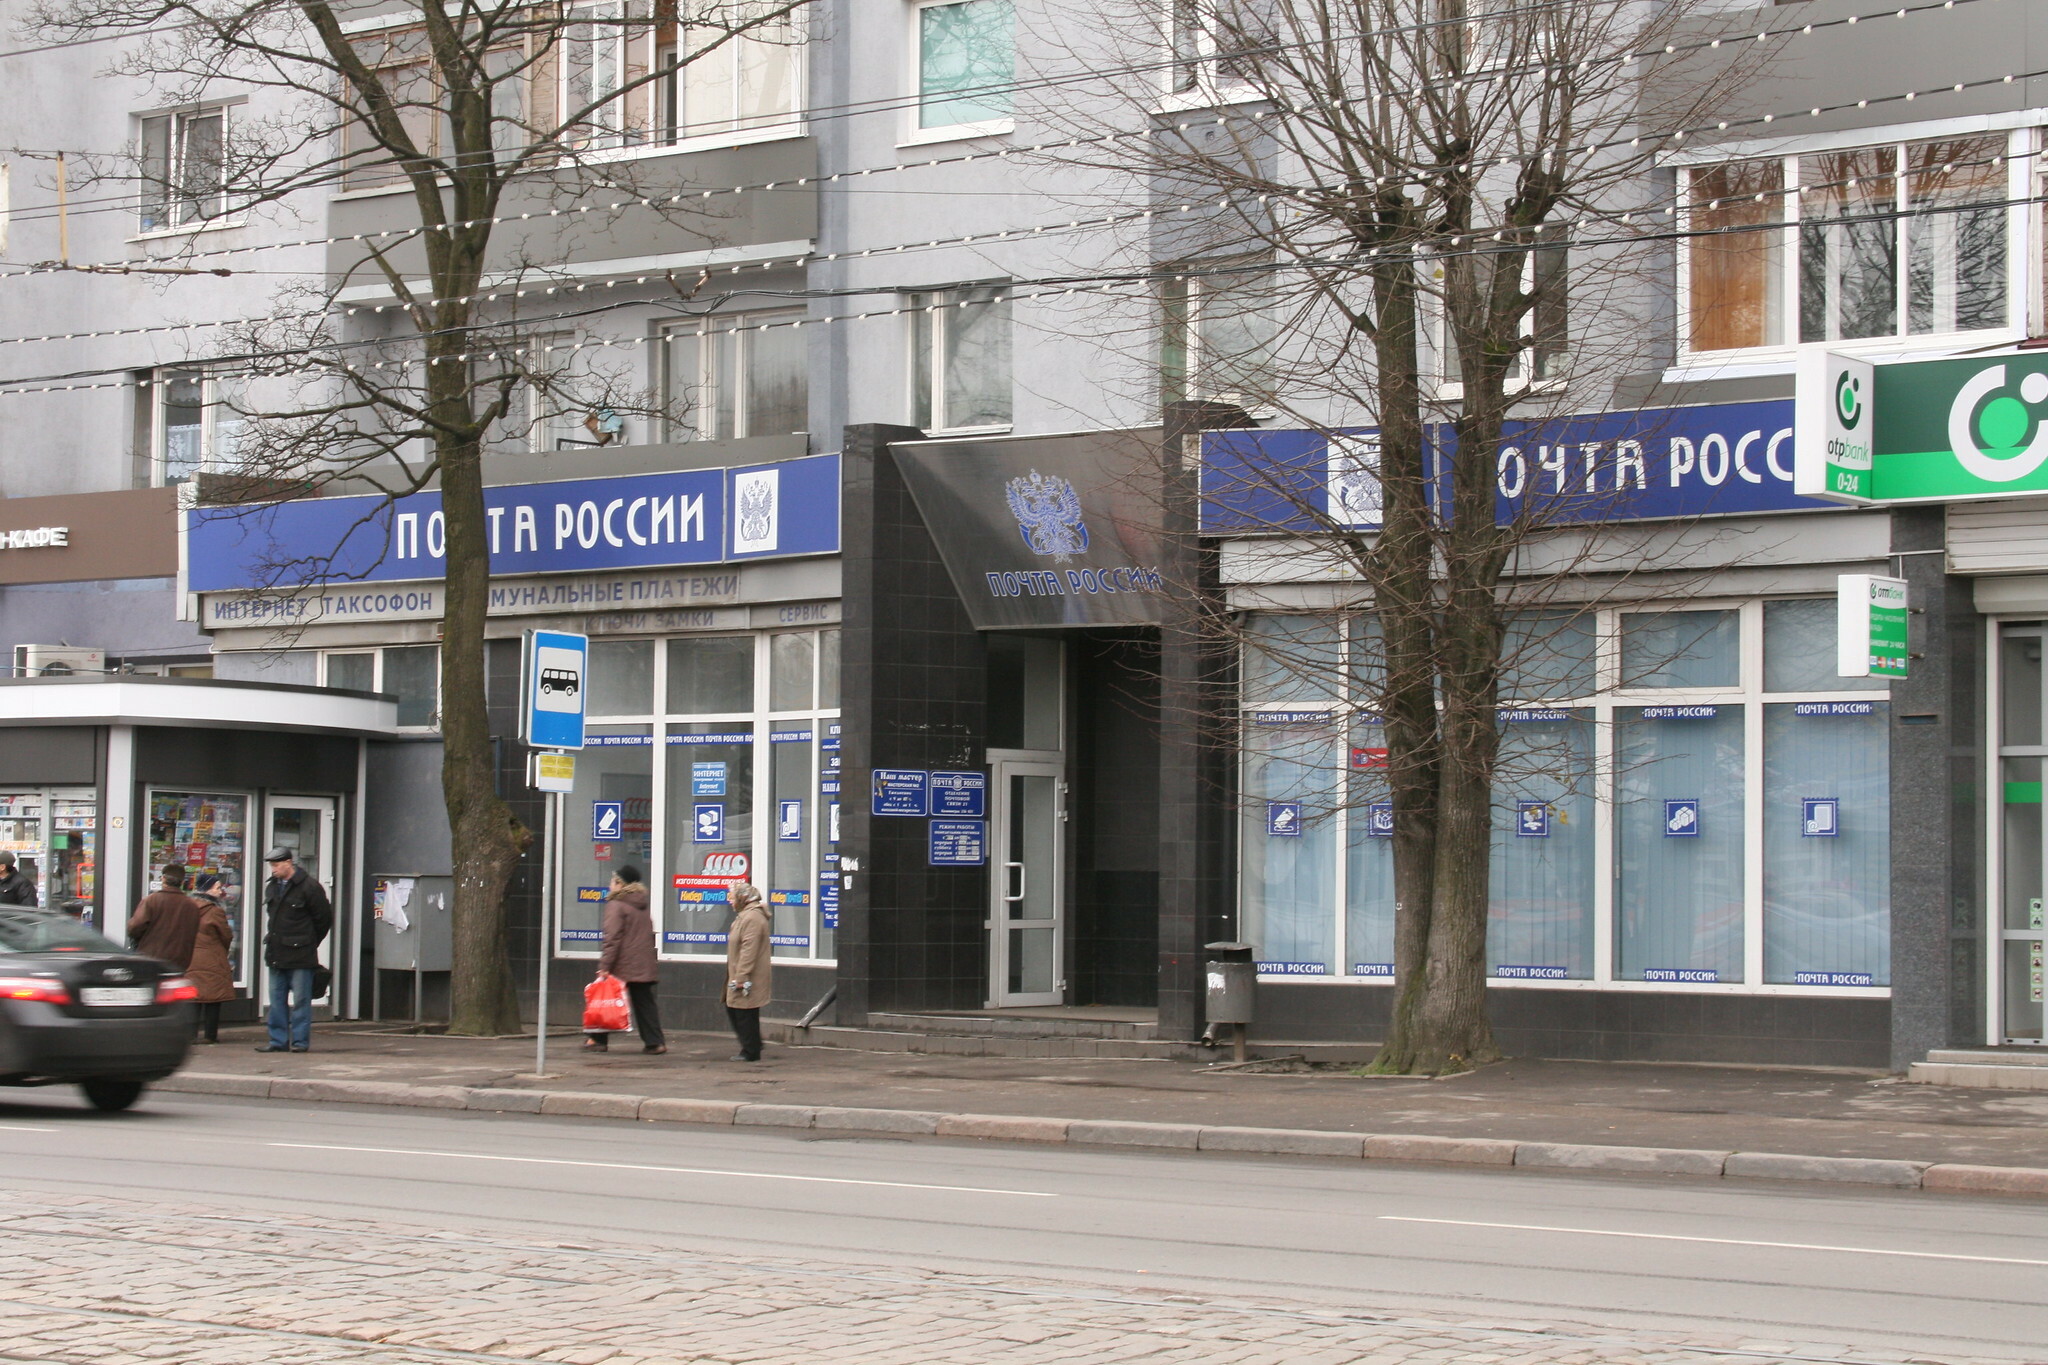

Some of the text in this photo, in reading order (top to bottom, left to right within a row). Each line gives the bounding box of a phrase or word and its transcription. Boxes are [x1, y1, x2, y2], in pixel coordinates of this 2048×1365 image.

[1828, 437, 1869, 462] otpbank
[1497, 427, 1794, 499] ОЧТА РОСС
[1837, 472, 1859, 493] 0-24
[397, 492, 705, 560] ПОТА РОССИИ
[0, 527, 69, 549] -КАФЕ
[986, 566, 1162, 597] ПОЧТА РОССИИ
[215, 575, 738, 620] ИНТЕРНЕТ ТАКСОФОН МУНАЛЬНЫЕ ПЛАТЕЖИ
[585, 604, 828, 631] КЛЮЧИ ЗАМКИ СЕРВИС
[1644, 707, 1713, 718] ПОЧТА РОССИИ
[1797, 703, 1870, 714] ПОЧТА РОССИИ
[1258, 714, 1288, 722] ПОЧТА
[1501, 711, 1567, 720] ПОЧТА РОССИИ
[584, 737, 601, 745] ОССИИ
[604, 737, 620, 745] ПОЧТА
[621, 736, 641, 744] РОССИИ
[665, 735, 682, 743] ПОЧТА
[683, 735, 704, 743] РОССИИ
[705, 735, 722, 743] ПОЧТА
[723, 734, 744, 742] РОССИИ
[675, 878, 720, 886] ИЗГОТОВЛЕНИЕ
[560, 931, 577, 939] ПОЧТА
[578, 931, 598, 939] РОССИИ
[668, 933, 685, 941] ПОЧТА
[685, 933, 706, 942] РОССИИ
[708, 934, 726, 942] ПОЧТА
[1288, 963, 1324, 974] РОССИИ
[1357, 964, 1389, 975] ПОЧТА
[1498, 967, 1564, 978] ПОЧТА РОССИИ
[1646, 970, 1715, 982] ПОЧТА РОССИИ
[1797, 973, 1870, 985] ПОЧТА РОССИИ
